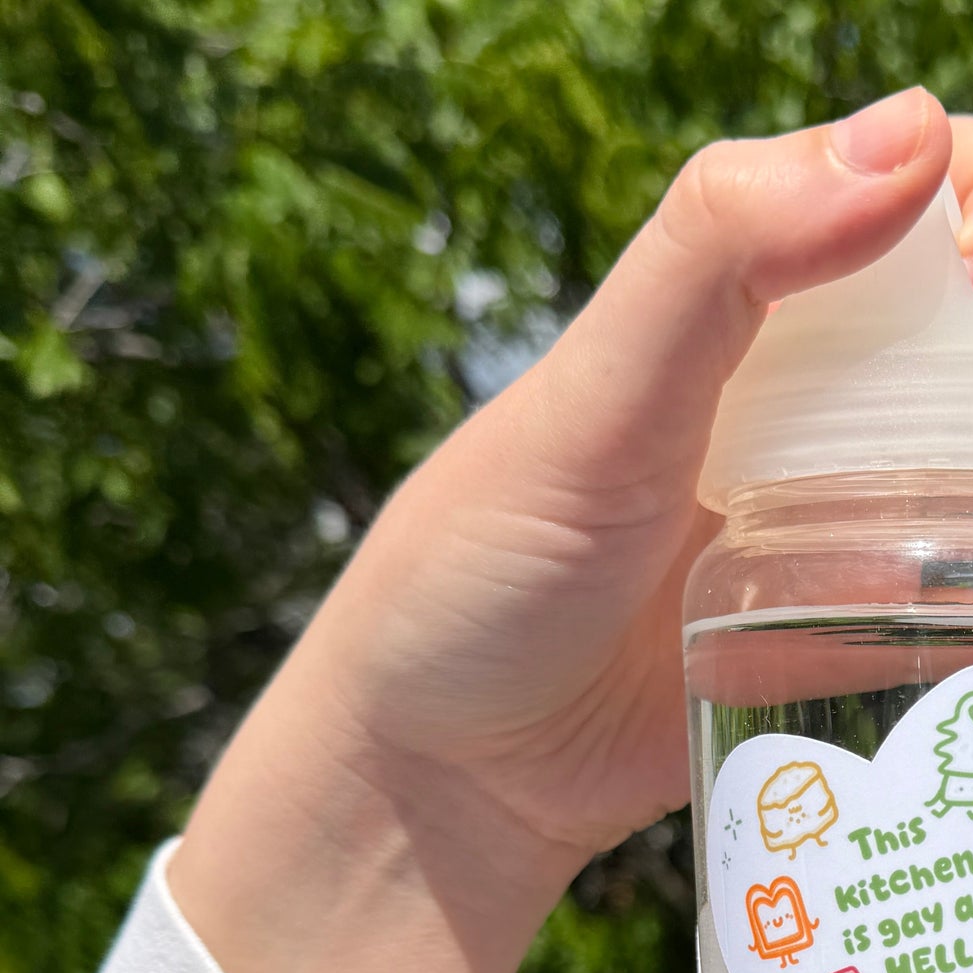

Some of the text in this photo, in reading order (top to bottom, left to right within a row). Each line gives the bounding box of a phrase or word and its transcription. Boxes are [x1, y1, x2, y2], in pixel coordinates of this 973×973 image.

[848, 816, 927, 860] This
[842, 924, 871, 955] is
[878, 901, 943, 948] gay
